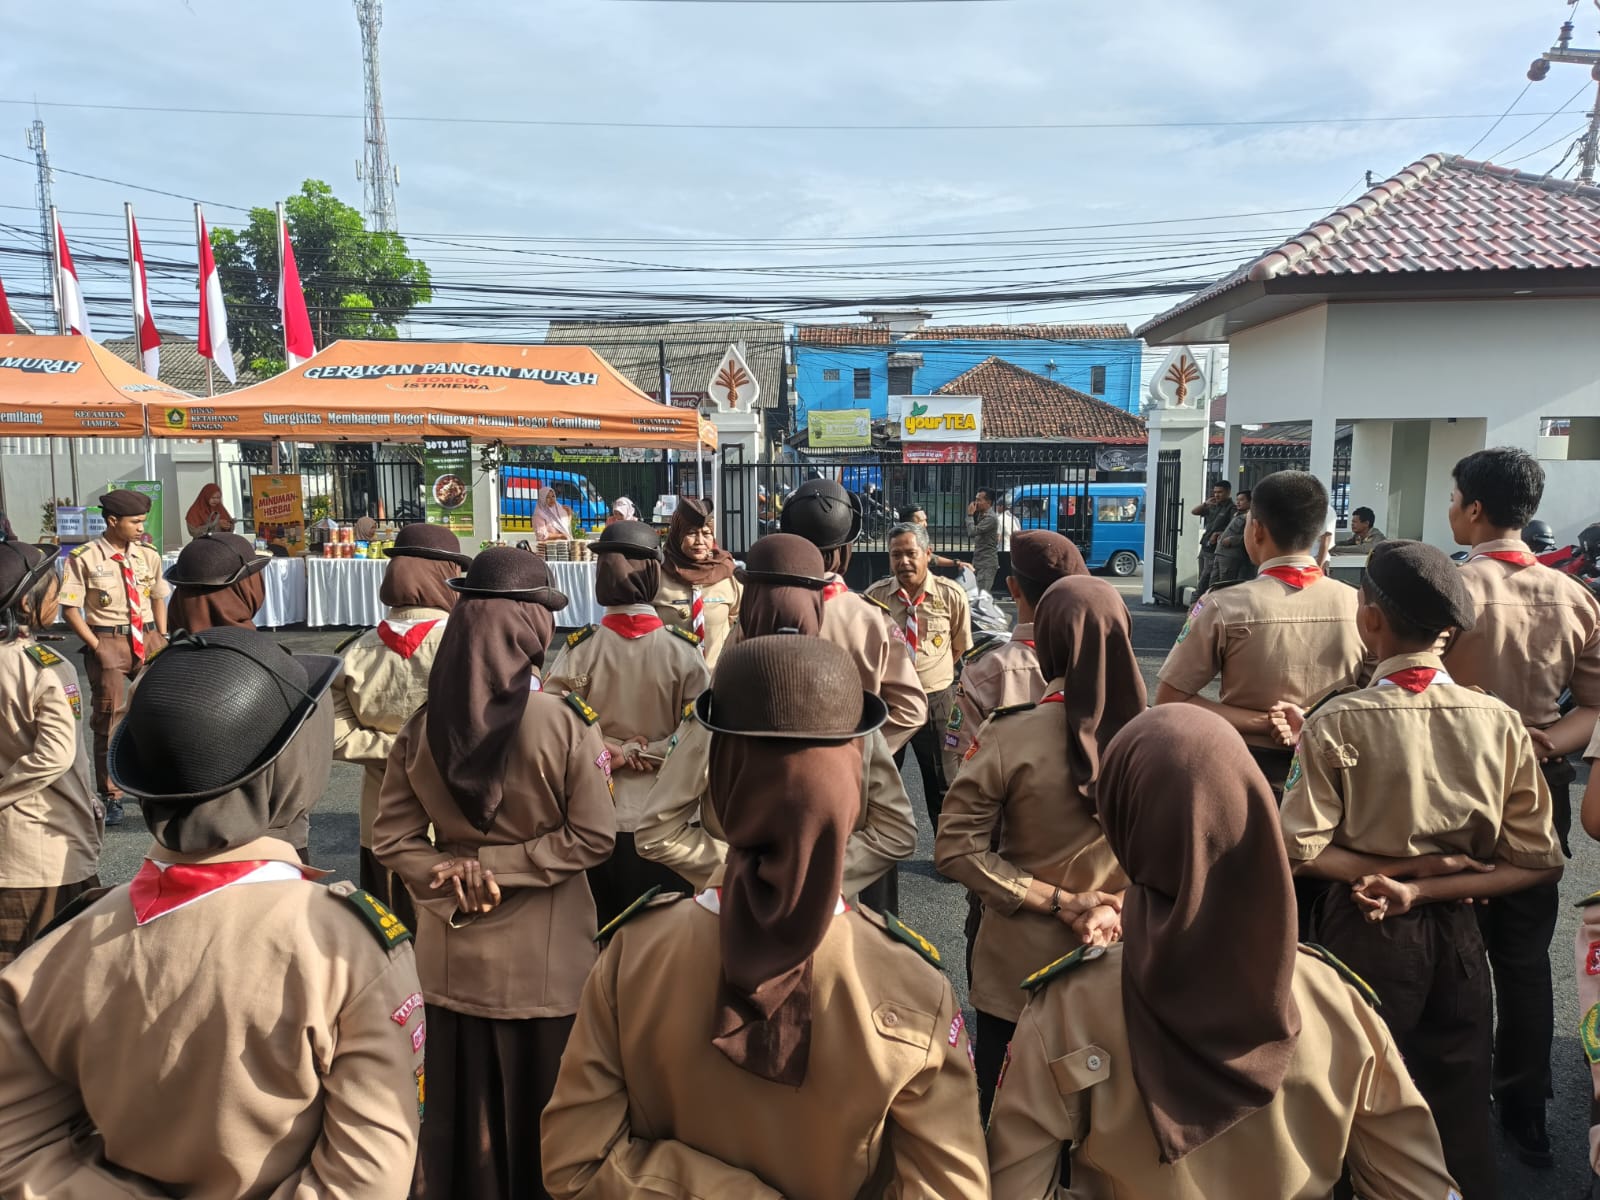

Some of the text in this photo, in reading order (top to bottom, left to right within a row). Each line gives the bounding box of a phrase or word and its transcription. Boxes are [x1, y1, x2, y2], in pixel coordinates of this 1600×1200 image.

[0, 357, 83, 374] MURAH
[303, 363, 599, 386] GERAKAN PANGAN MURAH
[74, 410, 125, 419] KECAMATAN
[263, 412, 601, 430] Sinergisitas Membangun Bogor Istimewa Menuju Bogor Gemilang
[81, 419, 120, 428] CIAMPEA
[425, 439, 467, 450] SOTO MIE
[259, 492, 296, 507] MINUMAN
